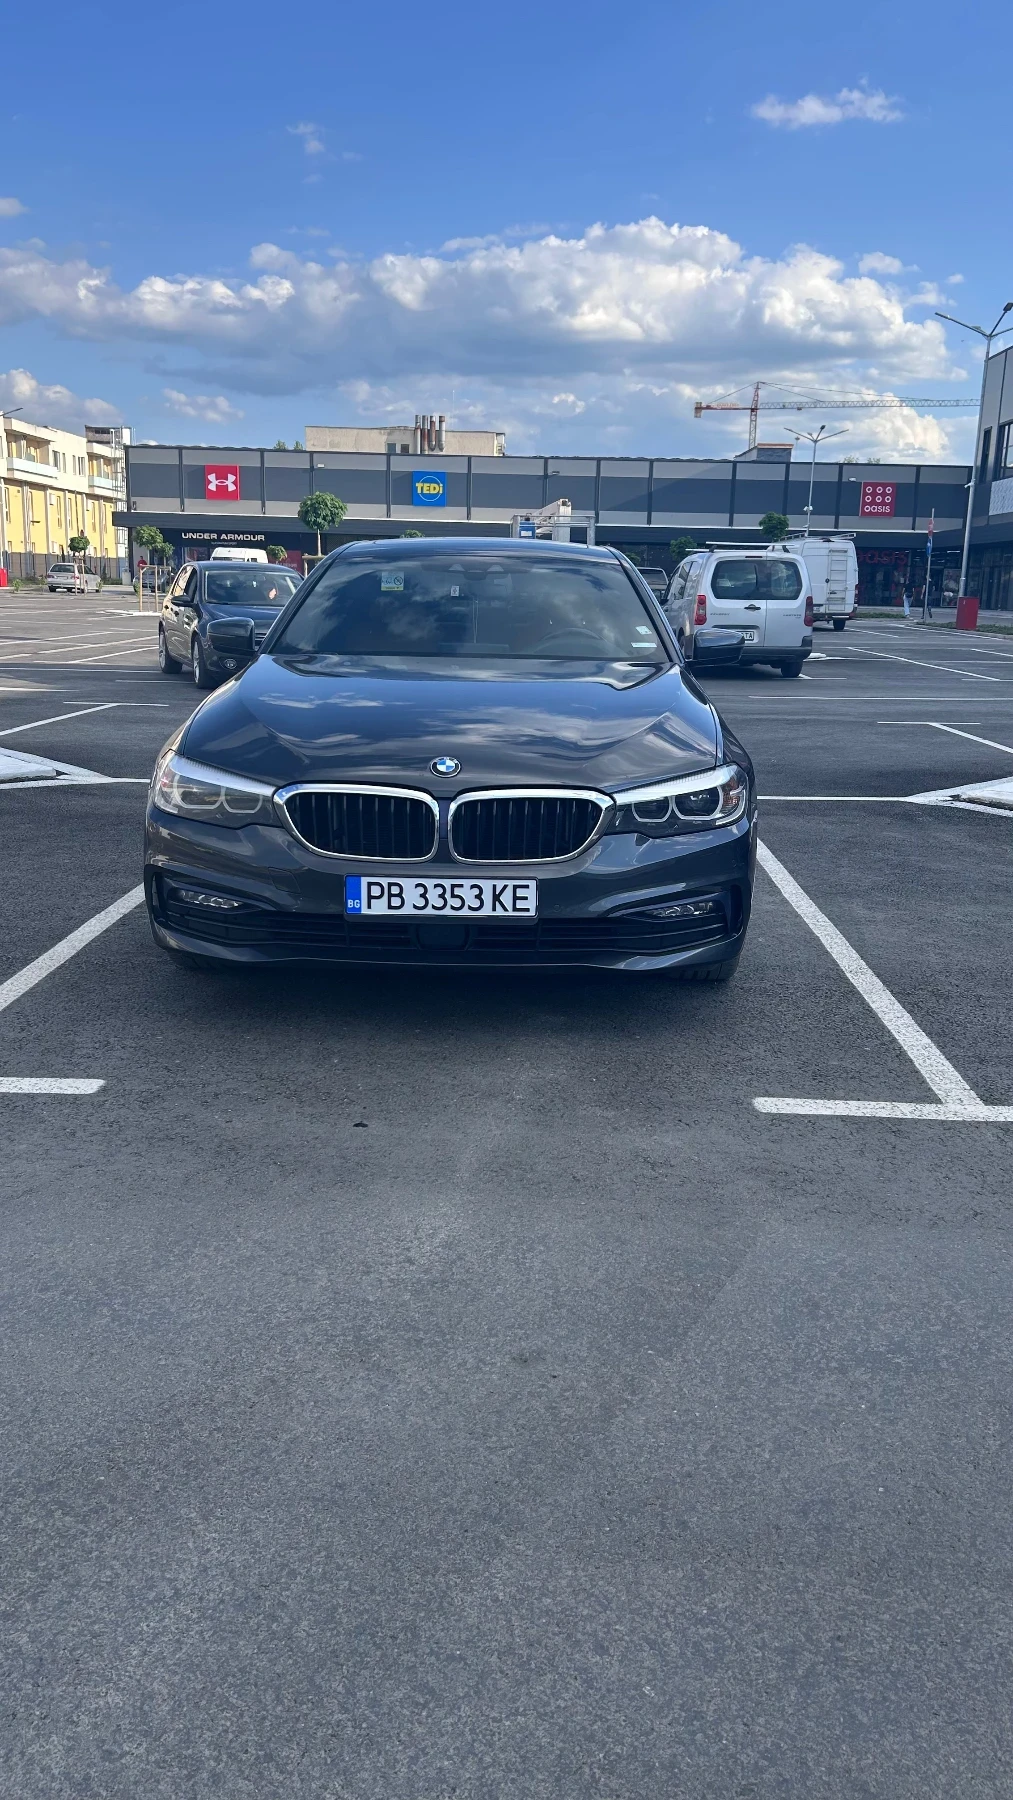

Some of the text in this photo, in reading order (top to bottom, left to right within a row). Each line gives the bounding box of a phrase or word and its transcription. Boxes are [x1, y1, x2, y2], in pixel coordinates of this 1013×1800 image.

[415, 482, 443, 494] TEDi
[864, 505, 891, 513] oasis
[182, 532, 265, 541] UNDER ARMOUR
[366, 881, 531, 913] PB 3353 KE
[347, 899, 361, 908] BG
